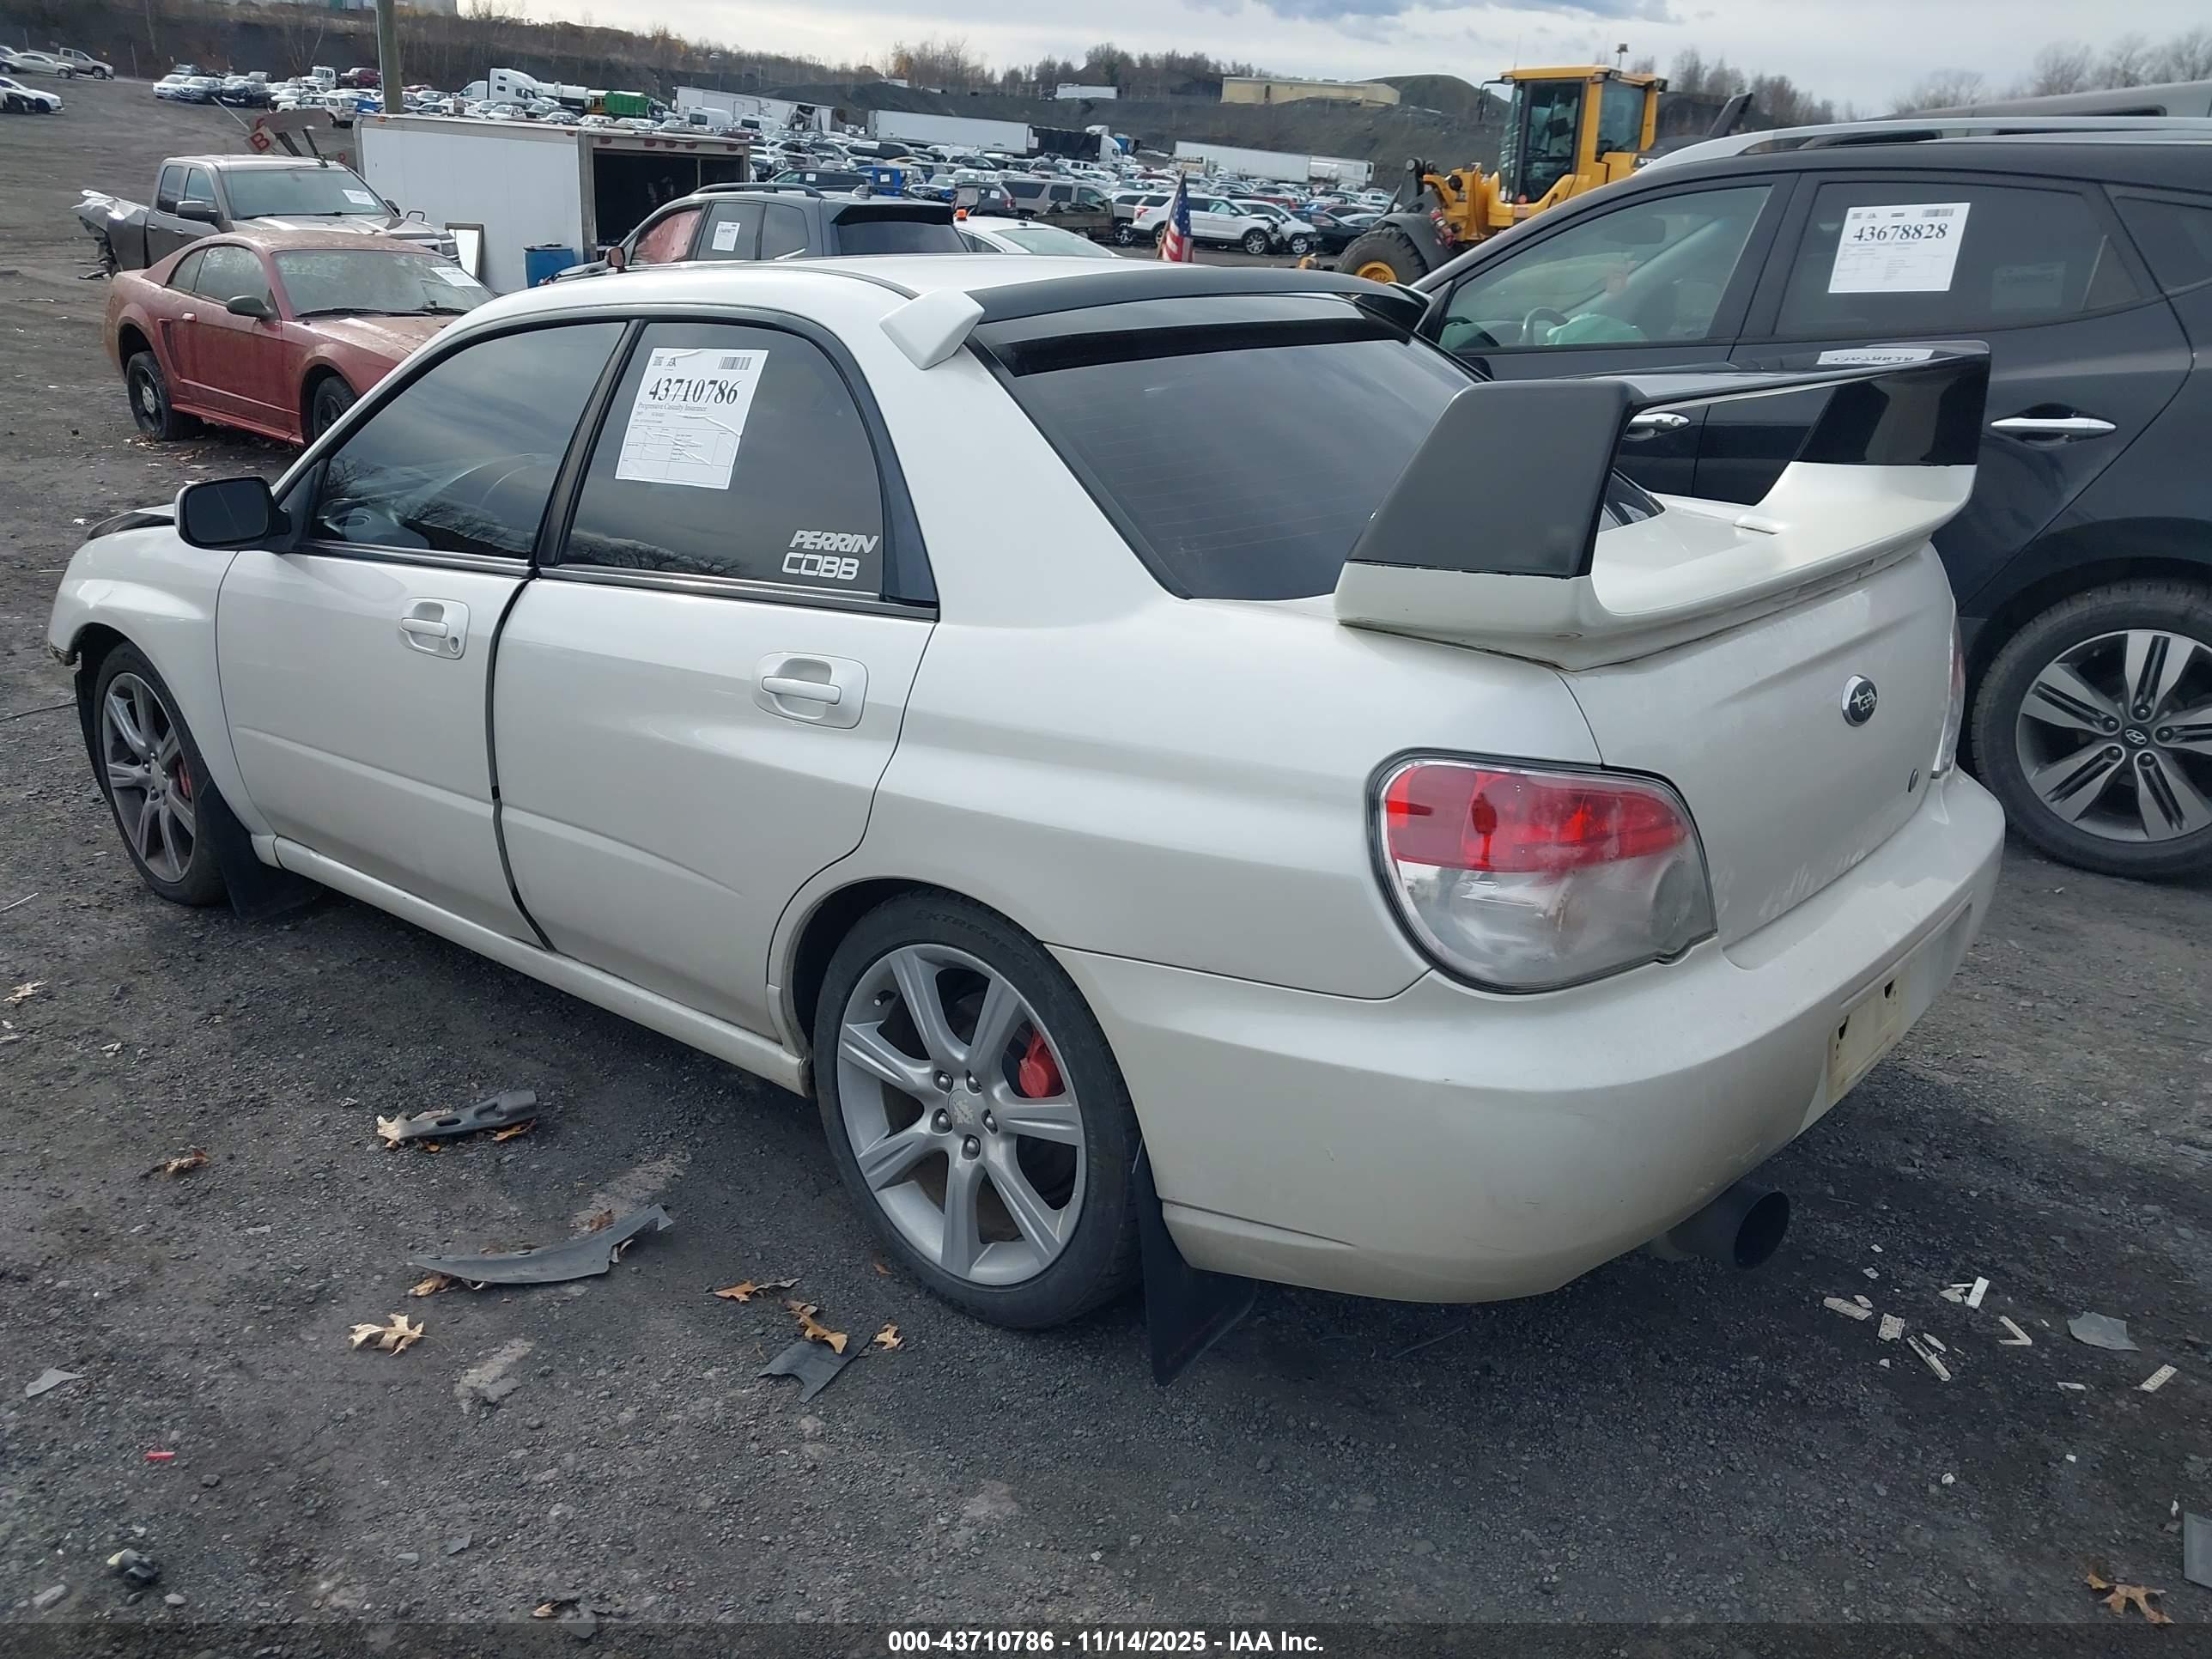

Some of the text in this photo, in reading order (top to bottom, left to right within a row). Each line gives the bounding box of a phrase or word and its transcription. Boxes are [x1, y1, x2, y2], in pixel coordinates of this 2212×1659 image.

[250, 132, 270, 151] B
[1853, 223, 1948, 241] 43678828
[648, 377, 742, 405] 43710786
[788, 530, 879, 554] PERRIN
[781, 551, 860, 580] COBB
